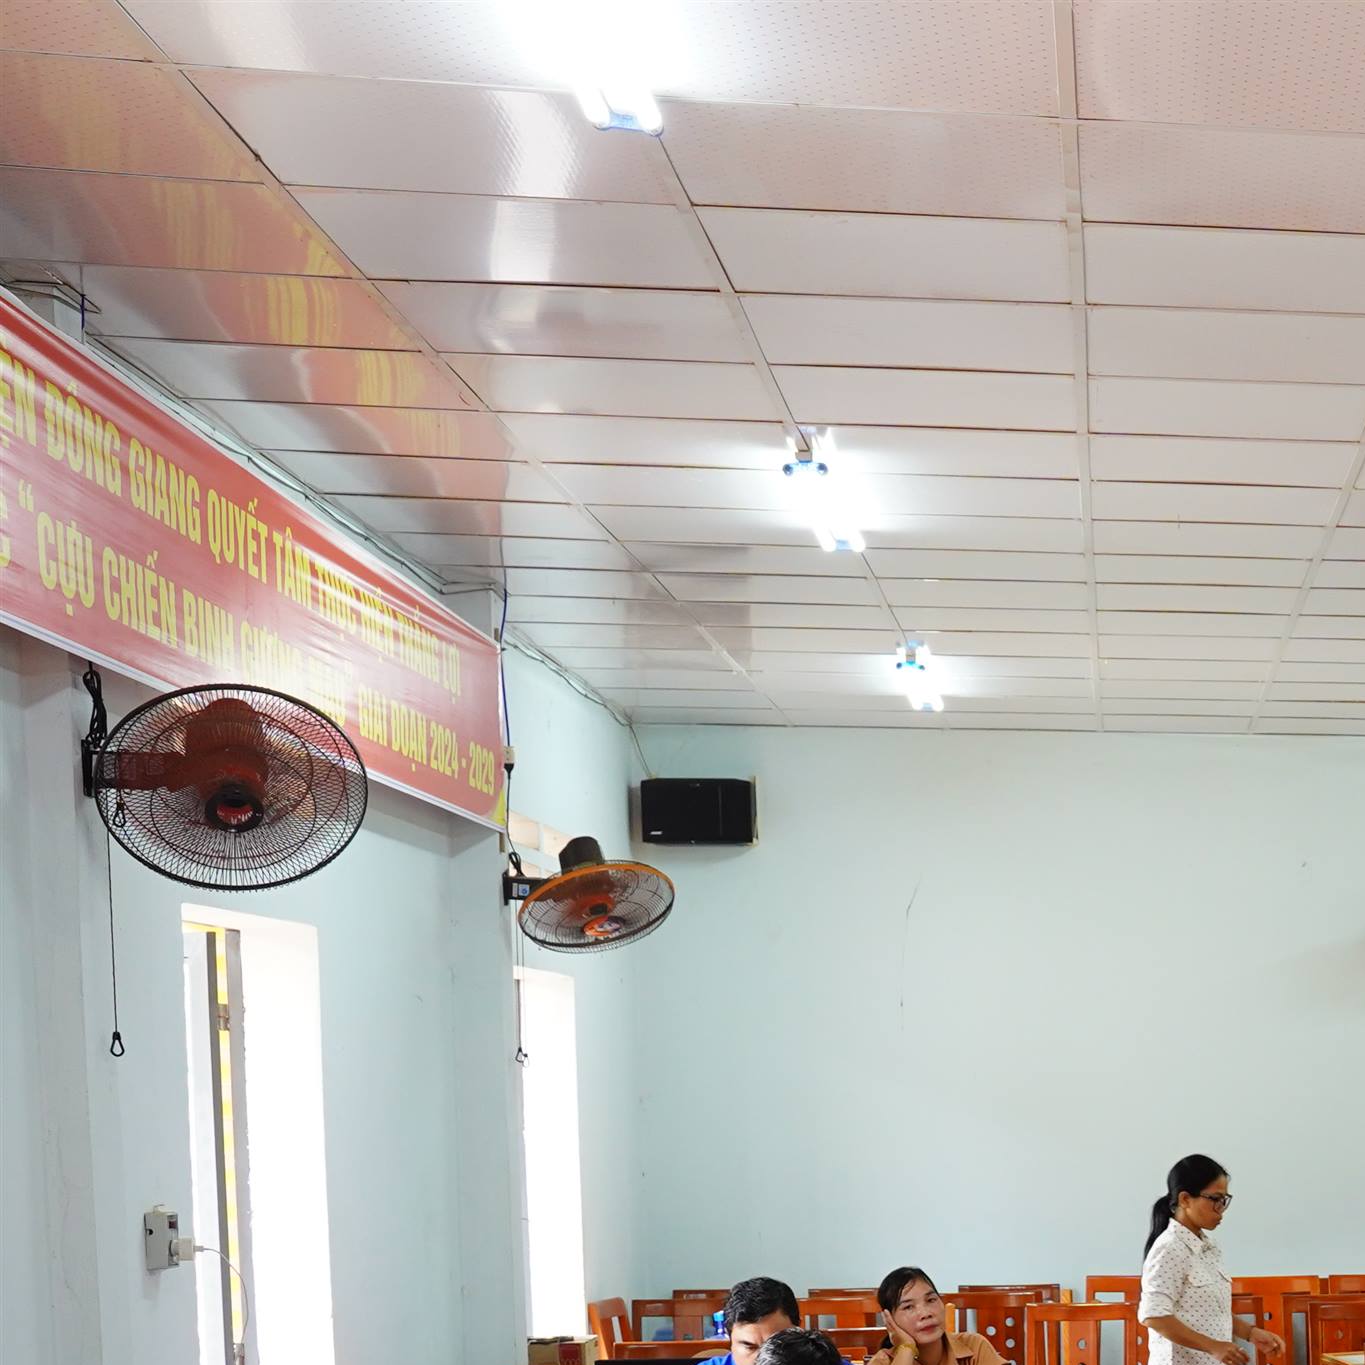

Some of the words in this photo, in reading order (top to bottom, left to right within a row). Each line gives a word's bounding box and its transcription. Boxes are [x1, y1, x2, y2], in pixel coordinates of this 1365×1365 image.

[45, 380, 122, 497] ĐÔNG
[129, 437, 201, 544] GIANG
[208, 489, 267, 584] QUYẾT
[273, 527, 312, 610] TÂM
[315, 560, 356, 641] THỰC
[102, 546, 178, 649] CHIẾN
[183, 588, 235, 672] BINH
[358, 682, 387, 747] GIAI
[391, 700, 427, 772] ĐOẠN
[430, 720, 458, 779] 2024
[469, 741, 495, 795] 2029
